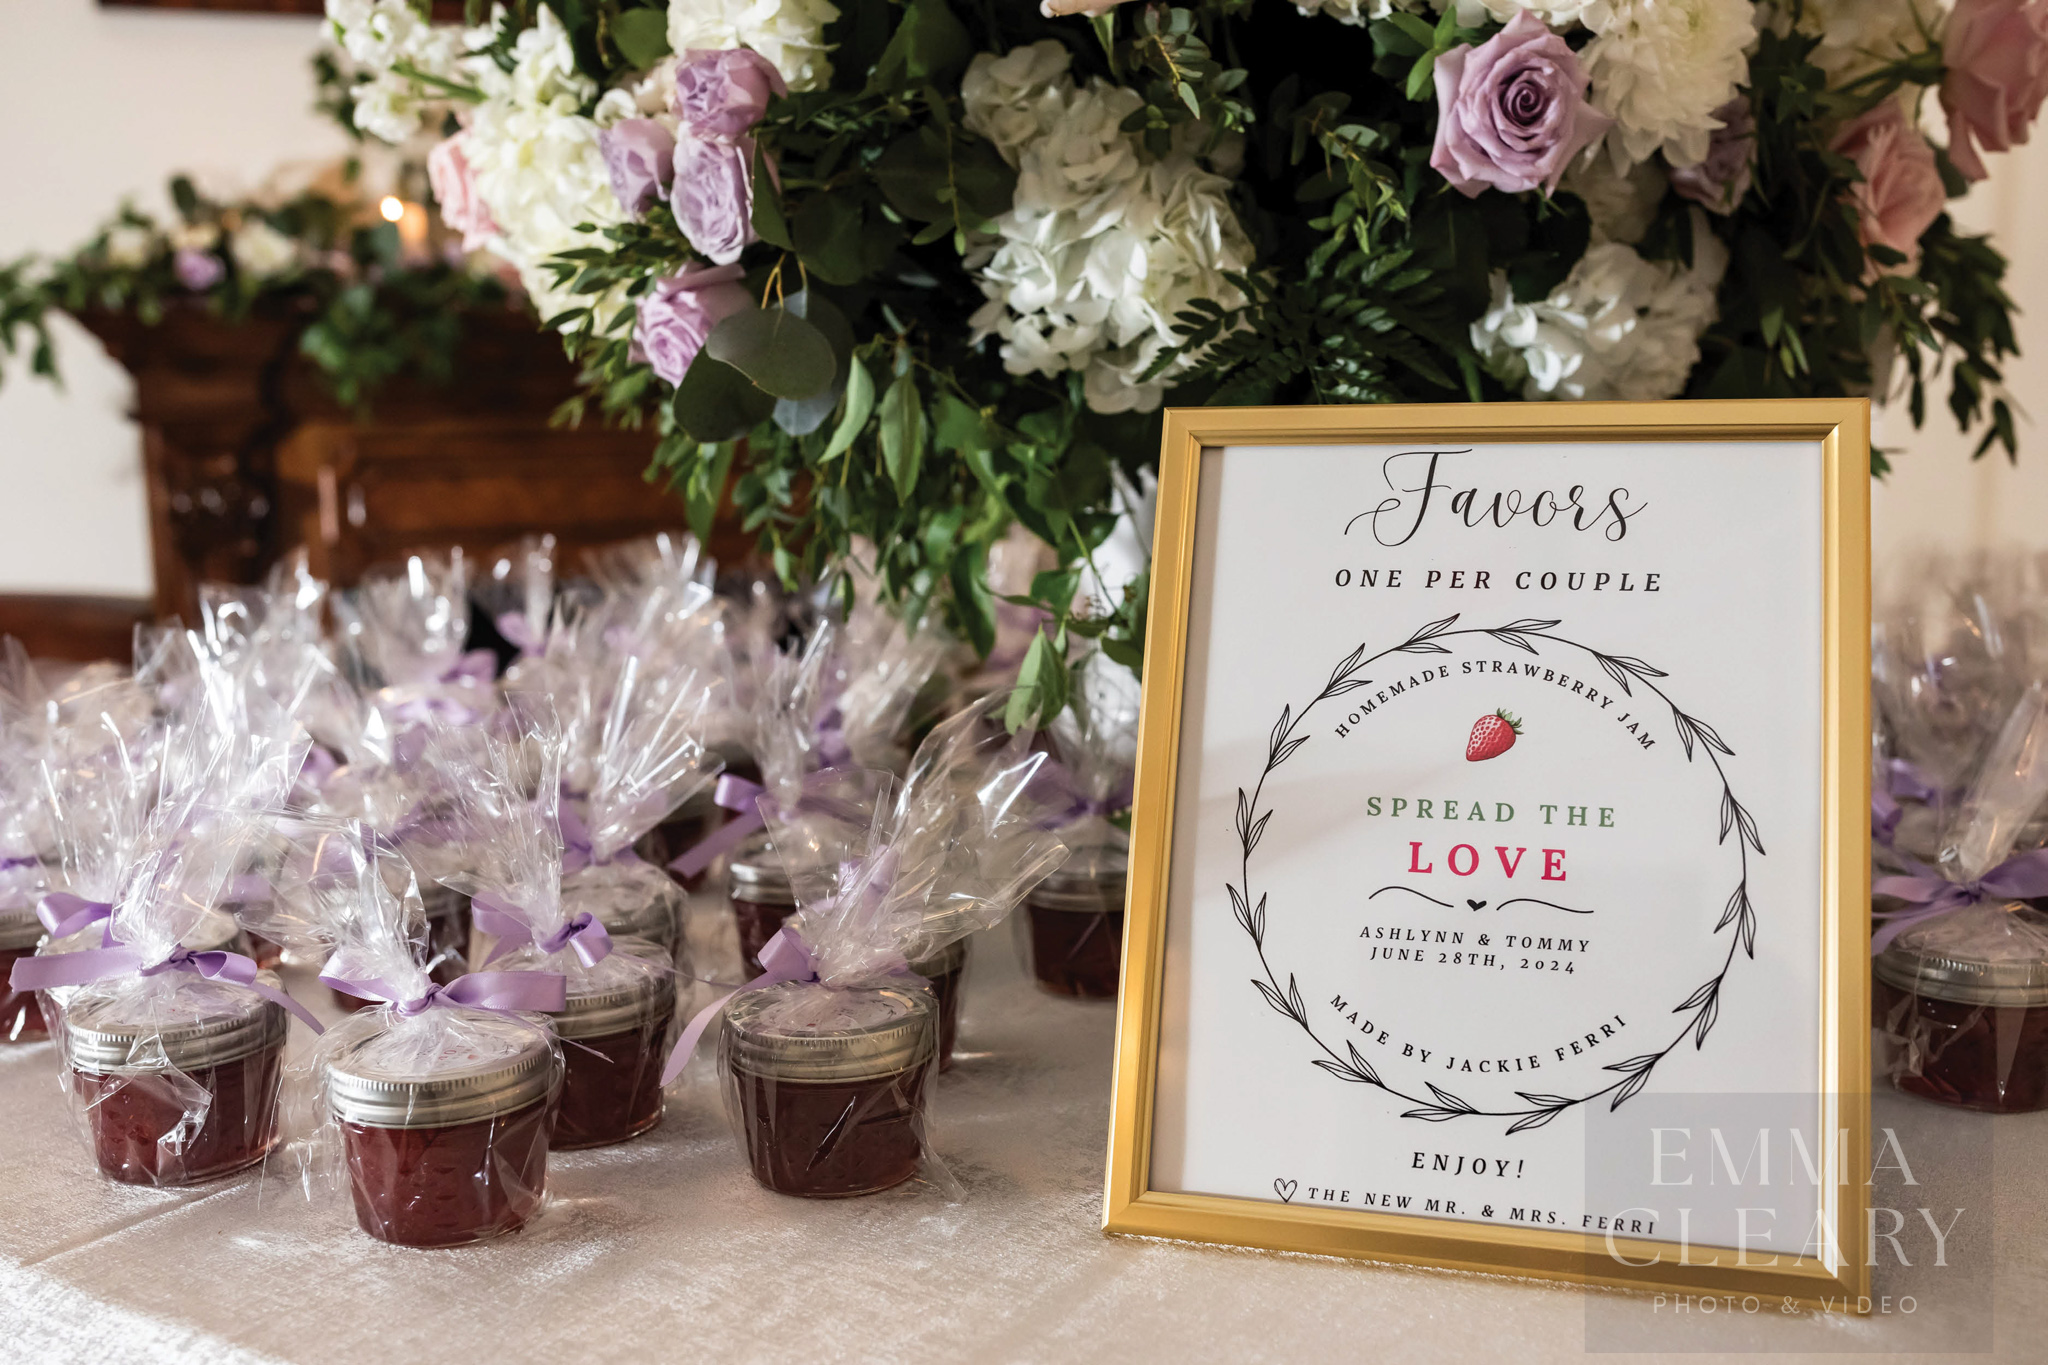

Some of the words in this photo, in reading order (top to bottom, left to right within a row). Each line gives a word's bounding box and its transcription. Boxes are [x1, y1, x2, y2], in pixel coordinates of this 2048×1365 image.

[1343, 448, 1648, 547] Favors
[1335, 568, 1402, 588] ONE
[1424, 570, 1491, 590] PER
[1515, 571, 1661, 592] COUPLE
[1334, 665, 1450, 739] HOMEMADE
[1461, 660, 1614, 712] STRAWBERRY
[1617, 712, 1656, 750] JAM
[1366, 796, 1515, 823] SPREAD
[1539, 804, 1615, 828] THE
[1407, 841, 1567, 882] LOVE
[1359, 926, 1464, 944] ASHLYNN
[1477, 933, 1491, 946] &
[1505, 935, 1590, 953] TOMMY
[1369, 946, 1425, 962] JUNE
[1438, 951, 1505, 971] 28TH,
[1520, 958, 1575, 975] 2024
[1330, 994, 1390, 1046] MADE
[1401, 1042, 1432, 1063] BY
[1445, 1054, 1541, 1073] JACKIE
[1554, 1014, 1626, 1062] FERRI
[1411, 1151, 1524, 1179] ENJOY!
[1308, 1187, 1350, 1203] THE
[1364, 1192, 1412, 1209] NEW
[1424, 1198, 1465, 1215] MR.
[1481, 1204, 1494, 1218] &
[1509, 1207, 1566, 1226] MRS.
[1582, 1214, 1654, 1235] FERRI
